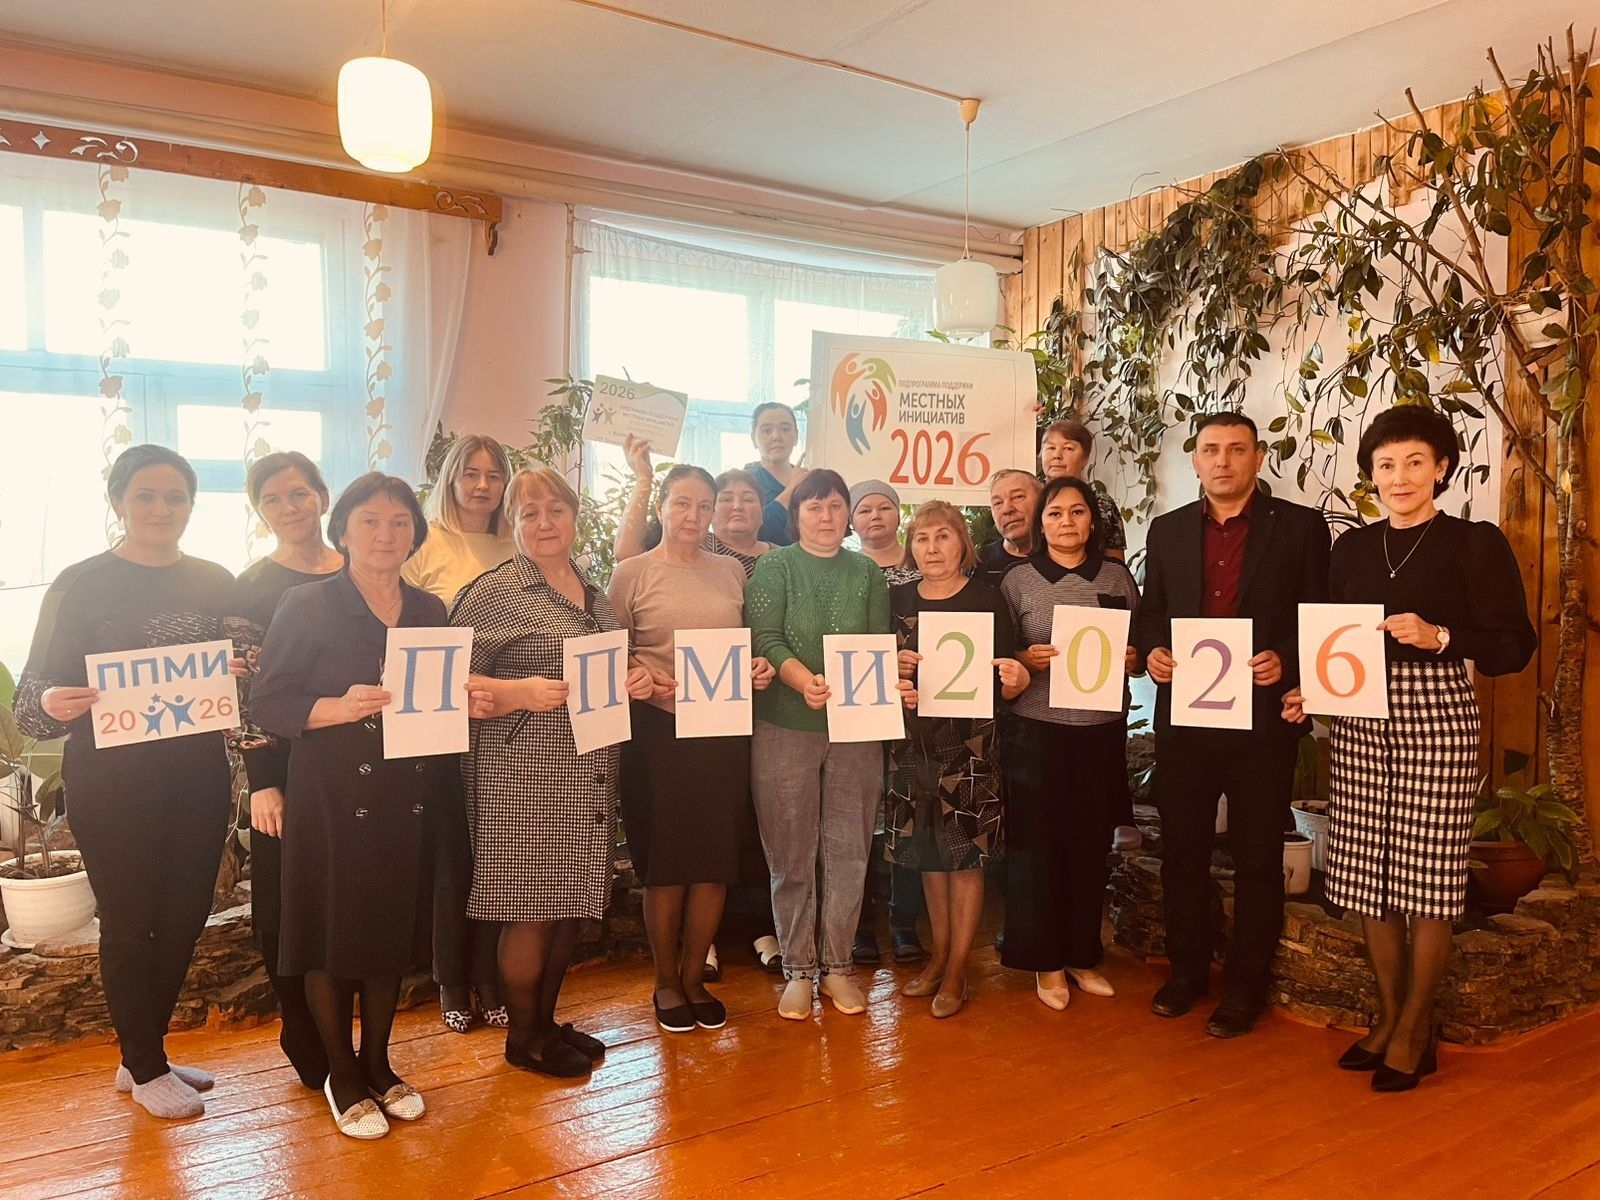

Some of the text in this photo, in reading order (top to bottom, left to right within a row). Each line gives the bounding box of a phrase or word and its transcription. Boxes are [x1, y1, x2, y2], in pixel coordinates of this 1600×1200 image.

[600, 382, 636, 400] 2026
[899, 380, 974, 390] ПОДПРОГРАММА ПОДДЕРЖКИ
[899, 392, 966, 410] МЕСТНЫХ
[899, 410, 966, 425] ИНИЦИАТИВ
[889, 428, 991, 486] 2026
[97, 648, 229, 691] ППМИ
[395, 623, 1366, 715] П П М И 2 0 2 6
[99, 696, 233, 734] 20 26
